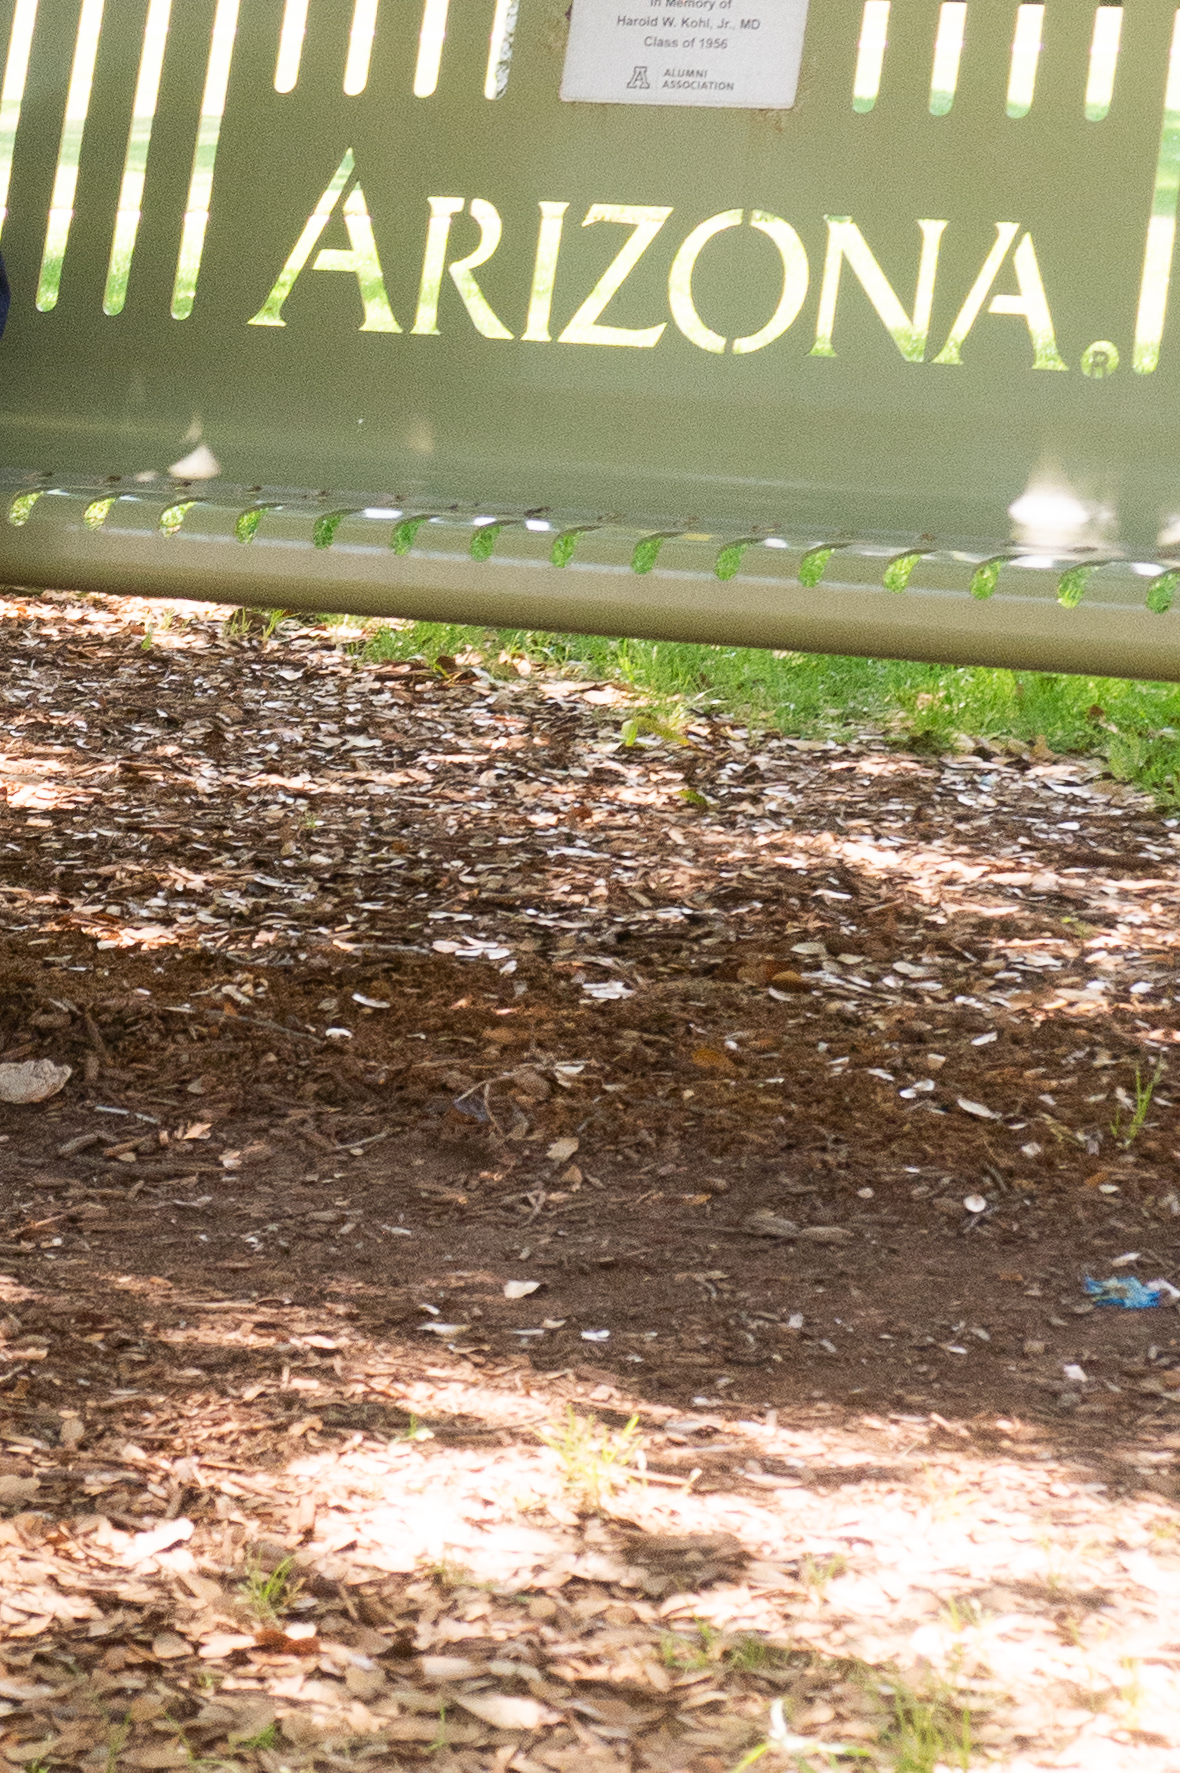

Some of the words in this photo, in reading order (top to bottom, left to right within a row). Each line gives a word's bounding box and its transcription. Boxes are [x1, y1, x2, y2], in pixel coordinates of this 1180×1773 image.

[616, 15, 658, 27] Harold
[662, 17, 677, 27] W.
[681, 17, 713, 29] Kohl,
[740, 19, 761, 30] MD
[643, 36, 678, 48] Class
[682, 37, 695, 48] of
[699, 38, 728, 49] 1956
[663, 68, 708, 78] ALUMNI
[661, 80, 735, 91] ASSOCIATION
